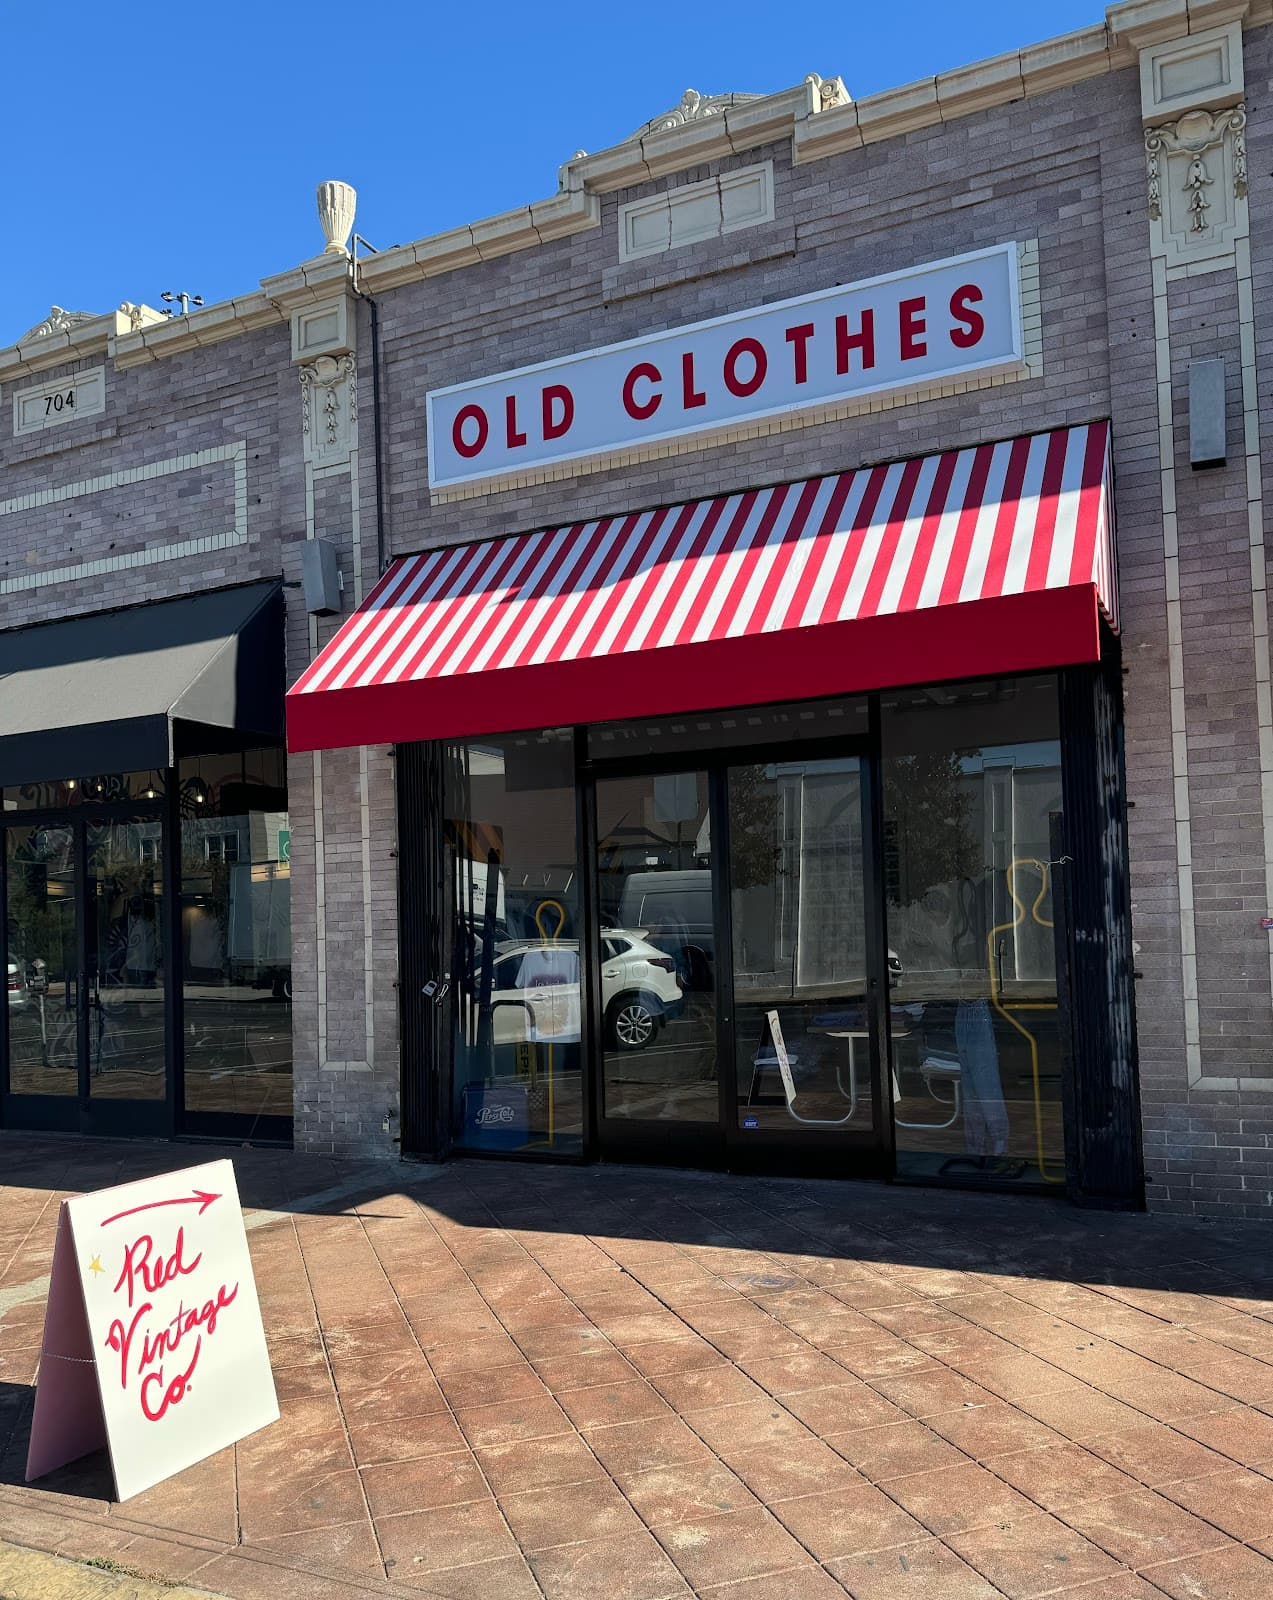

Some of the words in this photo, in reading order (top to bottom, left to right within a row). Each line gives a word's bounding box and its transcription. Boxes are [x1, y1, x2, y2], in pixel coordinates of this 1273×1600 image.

[44, 391, 74, 415] 704
[452, 384, 575, 458] OLD
[622, 283, 985, 420] CLOTHES
[114, 1226, 202, 1307] Red
[105, 1282, 239, 1389] Vintage
[140, 1335, 201, 1421] Co.
